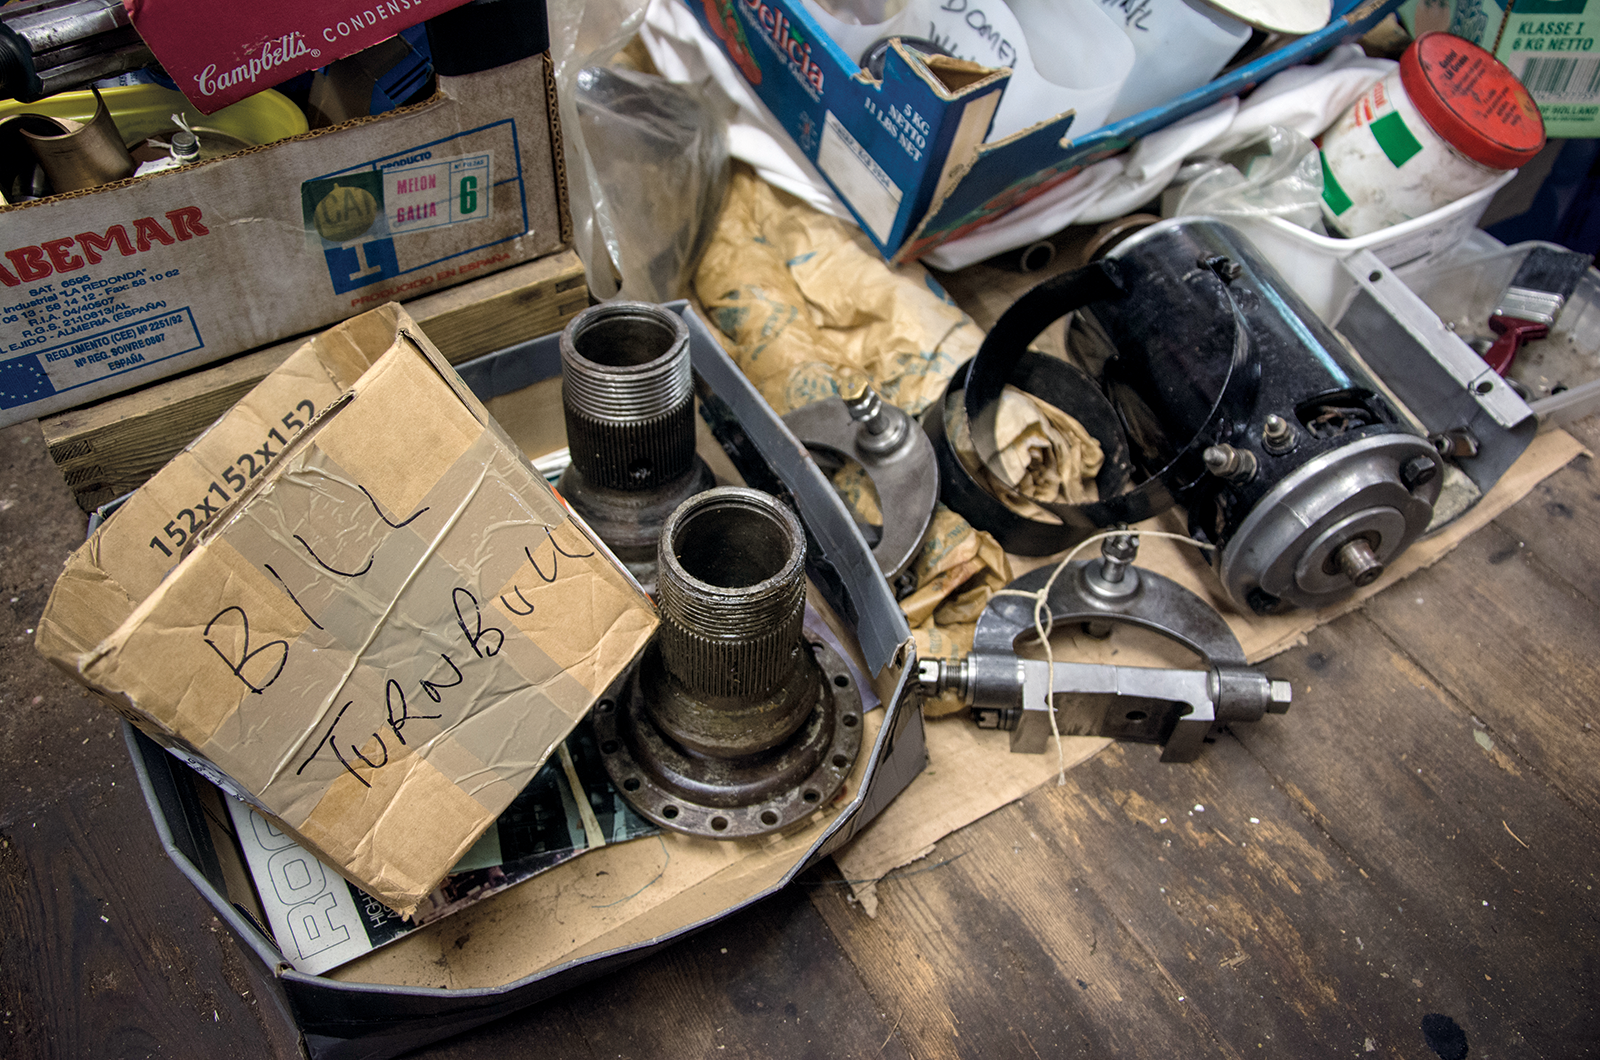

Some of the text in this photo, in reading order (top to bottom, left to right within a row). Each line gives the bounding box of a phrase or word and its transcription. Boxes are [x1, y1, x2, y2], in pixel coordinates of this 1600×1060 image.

[1518, 21, 1574, 36] KLASSE
[1524, 37, 1545, 51] KG
[1547, 37, 1594, 51] NETTO
[876, 109, 899, 139] LBS
[897, 132, 923, 162] NET
[887, 103, 926, 150] NETTO
[903, 103, 931, 137] 5 KG
[397, 174, 436, 195] MELON
[460, 175, 477, 215] 6
[397, 202, 437, 223] GALIA
[2, 314, 19, 324] 06
[21, 309, 36, 318] 13
[45, 301, 61, 312] 58
[64, 298, 78, 307] 14
[81, 293, 96, 302] 12
[105, 284, 130, 295] Fax:
[132, 279, 147, 288] 58
[150, 273, 163, 282] 10
[165, 268, 180, 278] 62
[3, 293, 58, 314] Industrial
[81, 268, 147, 292] REDONDA"
[29, 274, 91, 297] SAT. 6595
[351, 252, 511, 307] PRODUCIDO EN ESPAÑA
[8, 336, 47, 351] EJIDO
[57, 317, 110, 338] ALMERIA
[113, 300, 167, 322] (ESPAÑA)
[45, 336, 110, 362] REGLAMENTO
[111, 328, 137, 345] (CEE)
[149, 315, 183, 331] 2251/92
[88, 351, 111, 365] REG.
[110, 340, 145, 357] SOIVRE
[144, 333, 165, 346] 0807
[107, 353, 145, 371] ESPAÑA
[149, 399, 315, 558] 152x152x152
[203, 483, 430, 695] BILL
